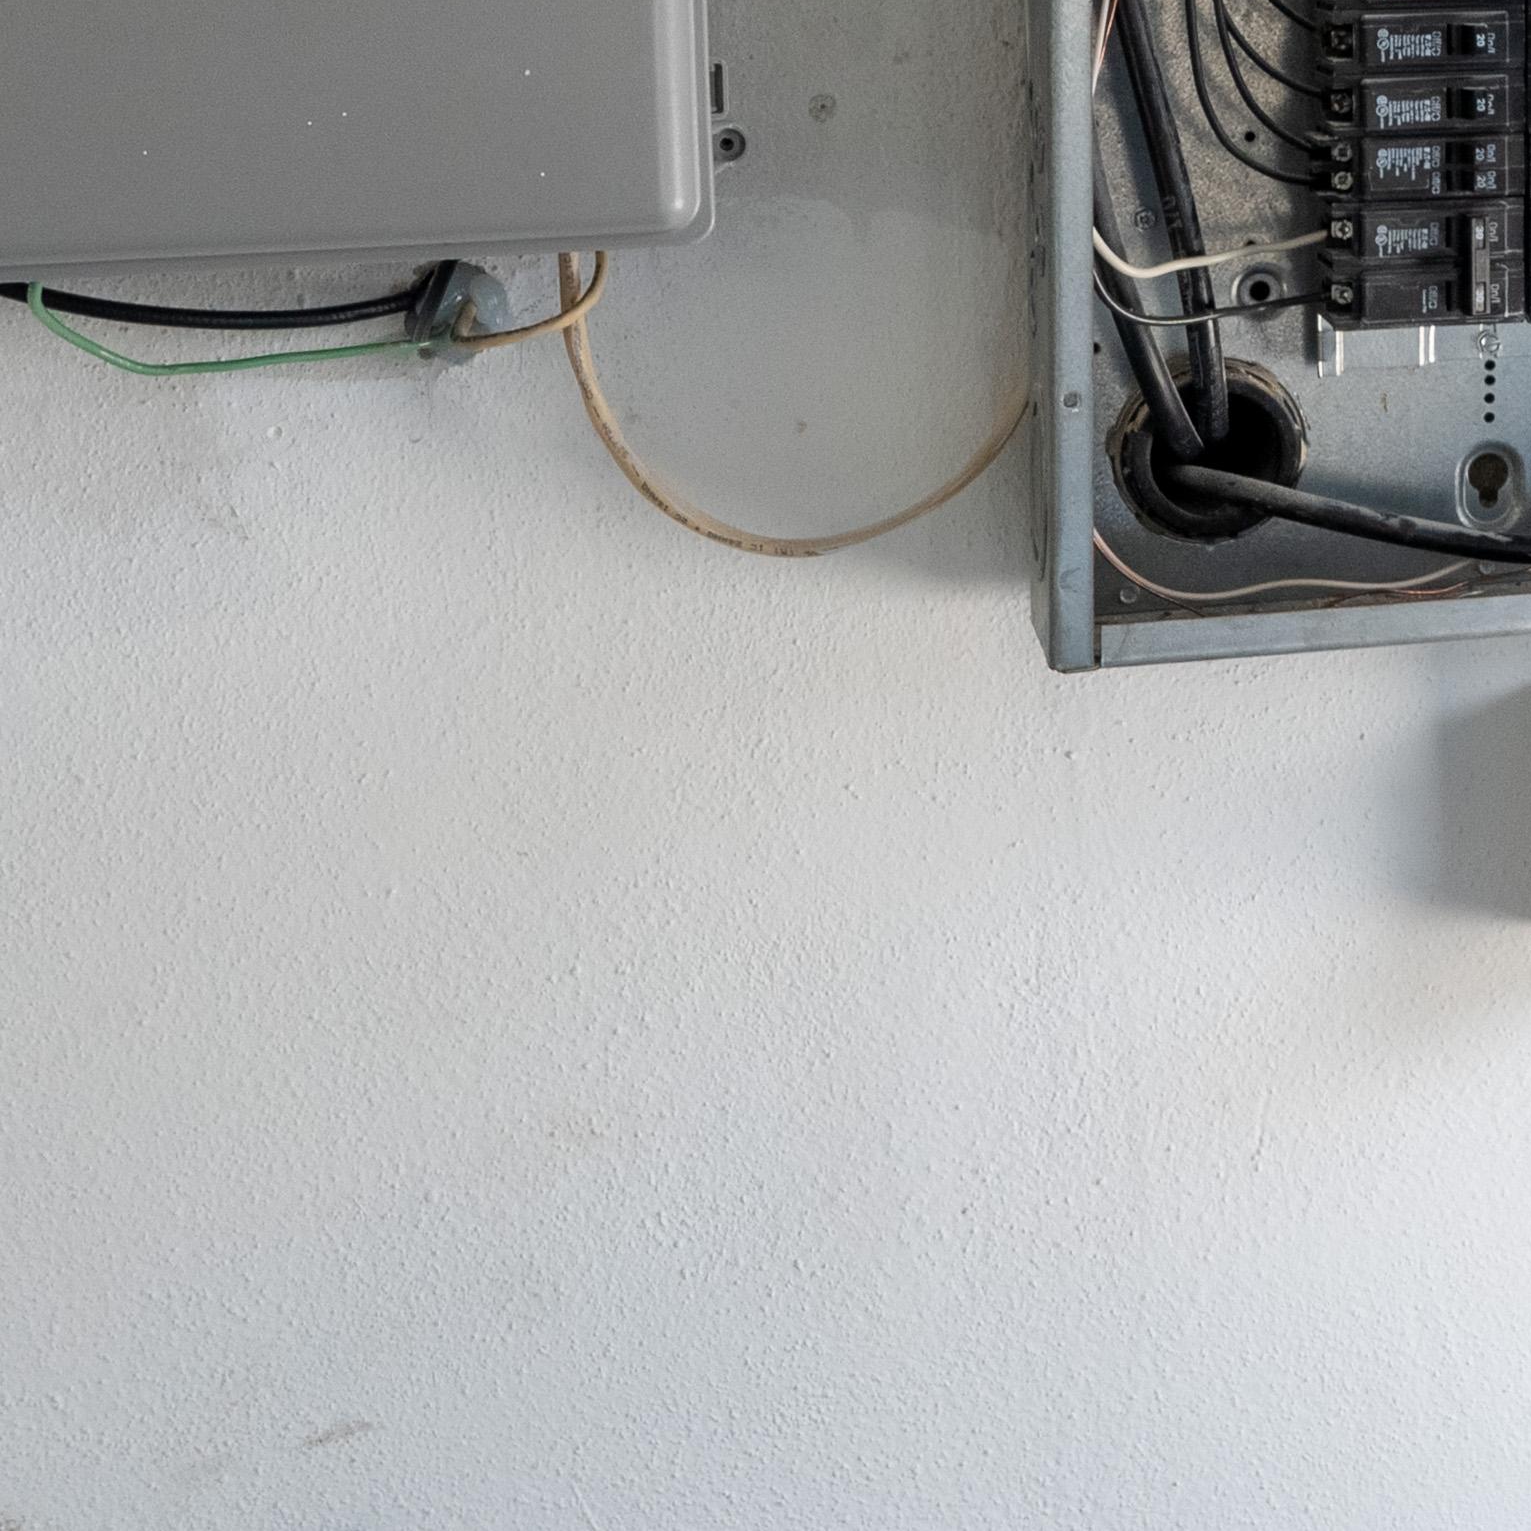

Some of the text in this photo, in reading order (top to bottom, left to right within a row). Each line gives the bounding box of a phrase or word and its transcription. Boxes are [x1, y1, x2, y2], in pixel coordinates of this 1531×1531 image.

[1476, 34, 1485, 47] 20
[1477, 98, 1485, 111] 20
[1476, 148, 1485, 161] 20
[1477, 176, 1486, 188] 20
[1476, 226, 1484, 240] 30
